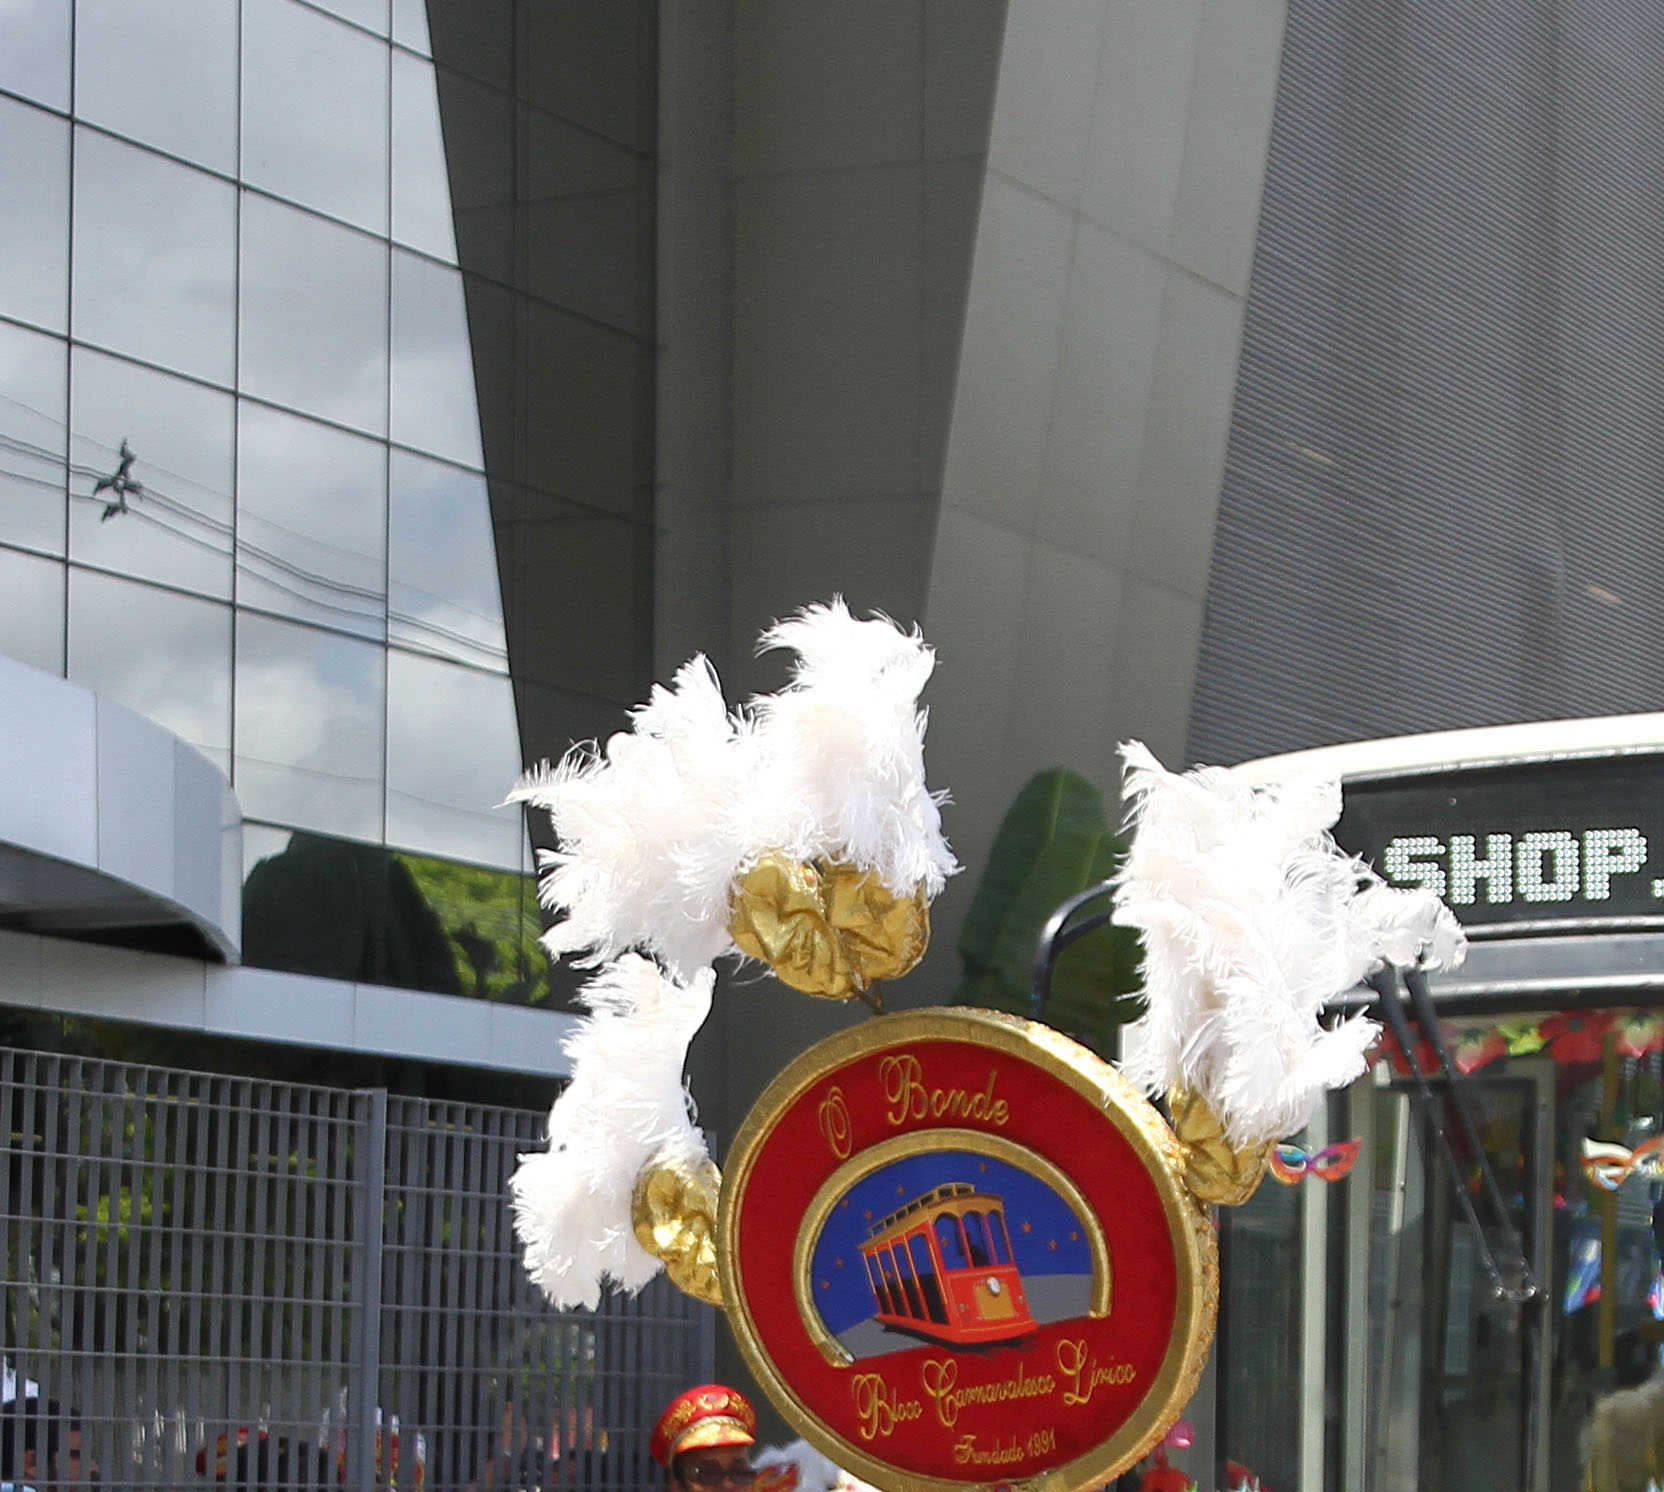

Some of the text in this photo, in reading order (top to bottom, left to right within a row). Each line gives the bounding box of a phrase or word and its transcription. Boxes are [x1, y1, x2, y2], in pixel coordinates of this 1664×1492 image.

[819, 1054, 1010, 1159] O Bonde
[852, 1373, 923, 1440] Bloco
[922, 1358, 1056, 1431] Carnavalesco
[954, 1434, 1024, 1465] Fundado
